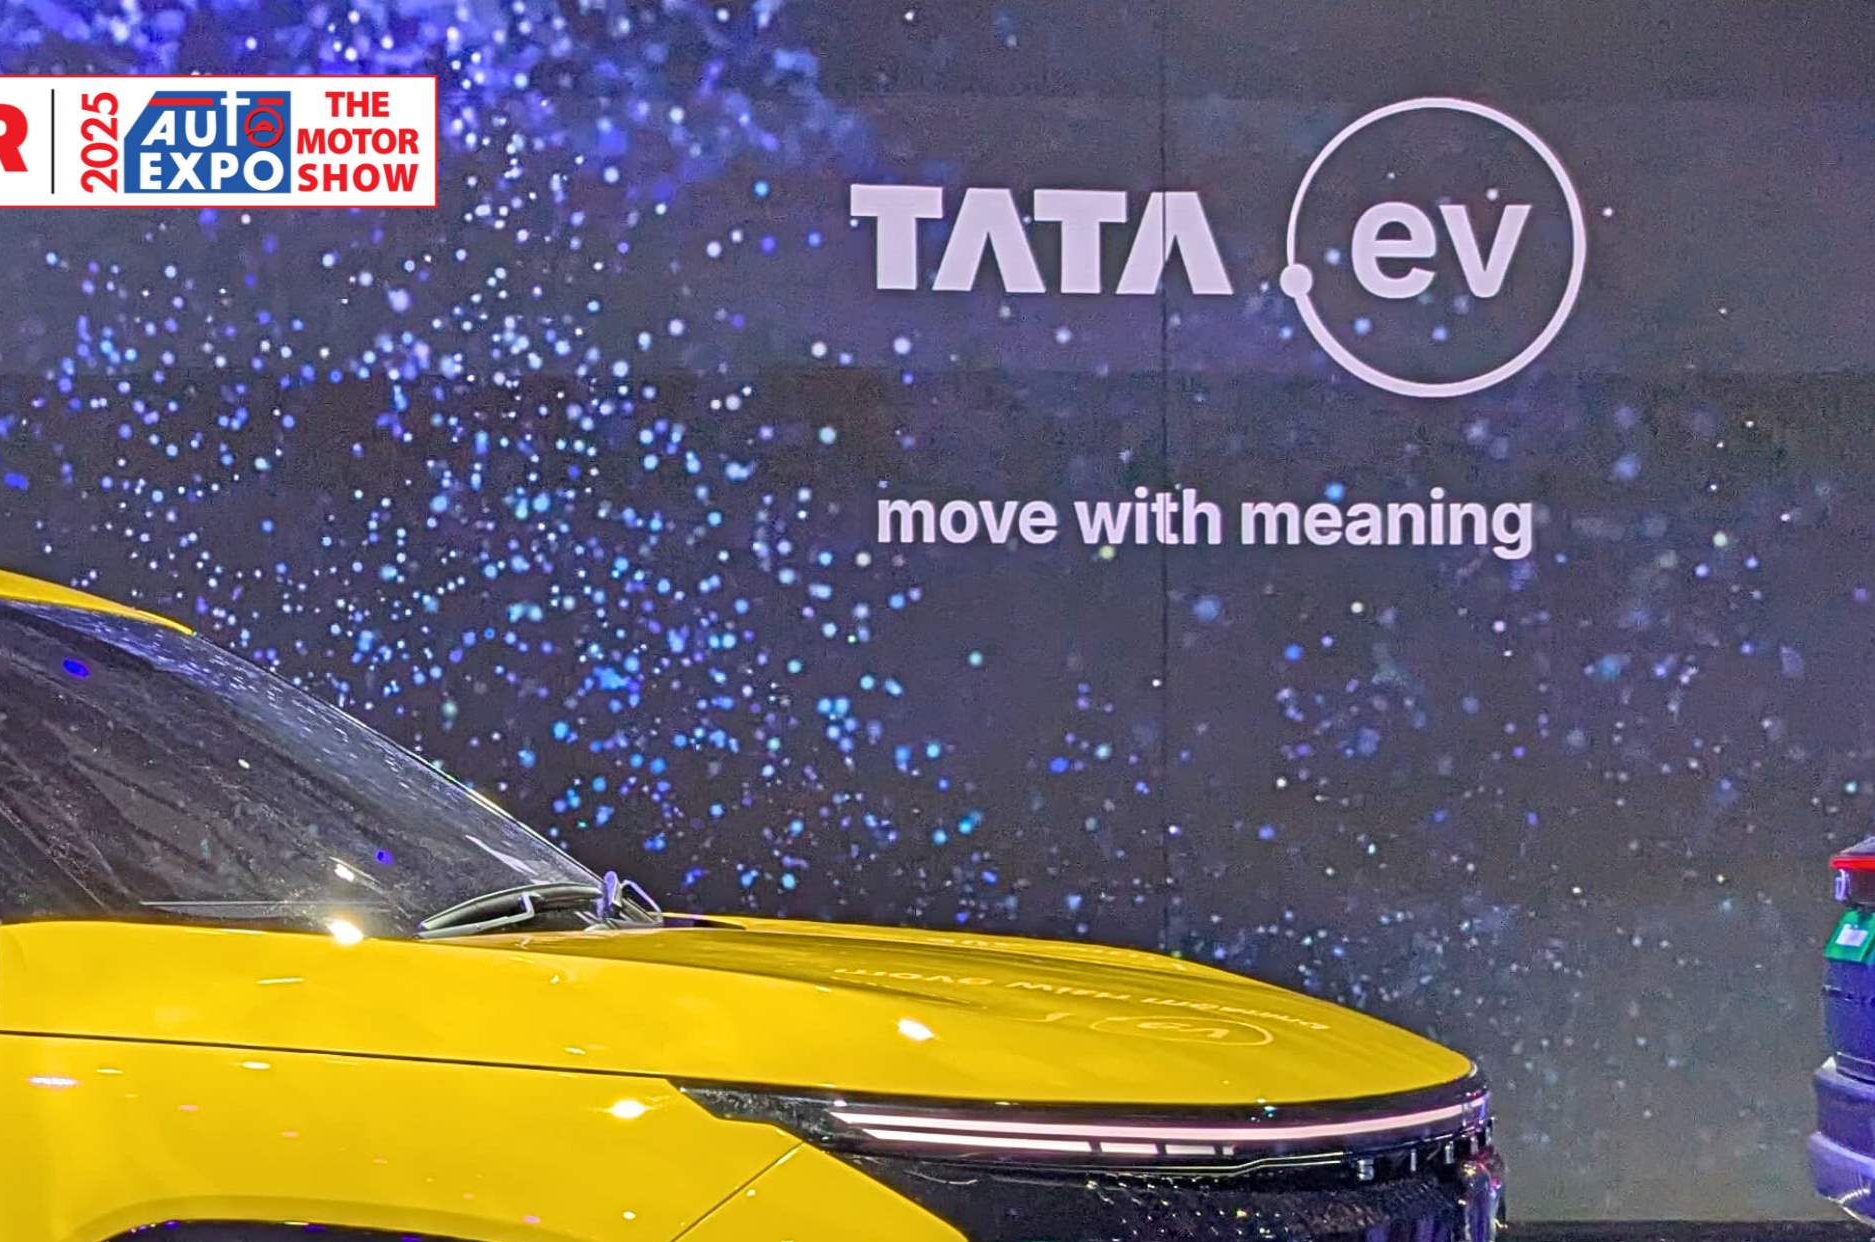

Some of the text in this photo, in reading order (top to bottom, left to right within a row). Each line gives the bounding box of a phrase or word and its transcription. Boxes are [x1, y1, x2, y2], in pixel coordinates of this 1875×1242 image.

[850, 184, 1531, 298] TATA ev
[878, 486, 1533, 559] move with meaning
